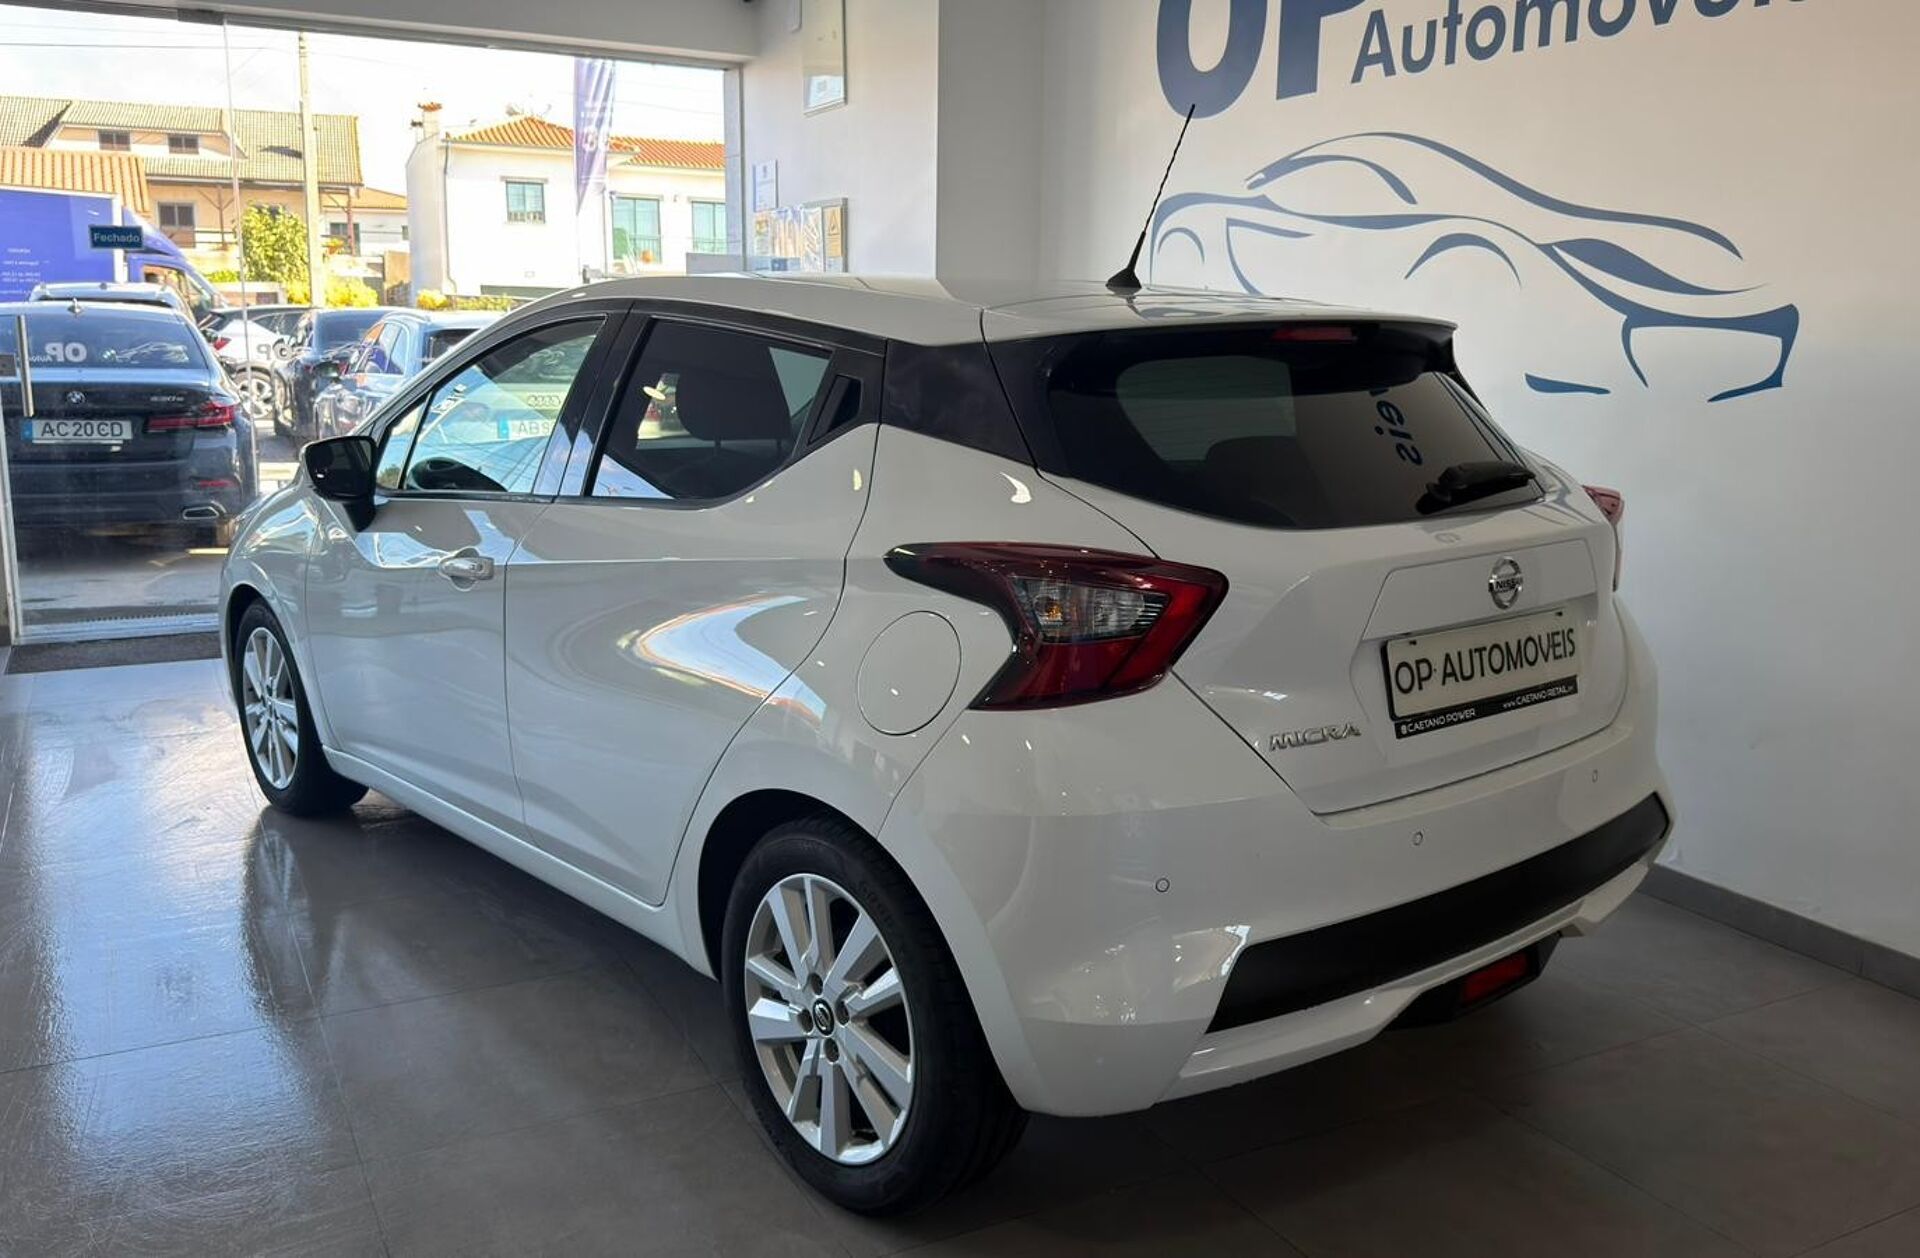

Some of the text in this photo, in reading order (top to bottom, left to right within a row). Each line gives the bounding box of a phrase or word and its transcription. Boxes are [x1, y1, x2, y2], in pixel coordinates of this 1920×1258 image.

[93, 231, 140, 242] Fechado
[41, 422, 69, 437] AC
[72, 422, 94, 437] 20
[1395, 628, 1576, 694] OP AUTOMOVEIS
[1446, 708, 1476, 722] POWER
[1270, 723, 1361, 751] MICRA
